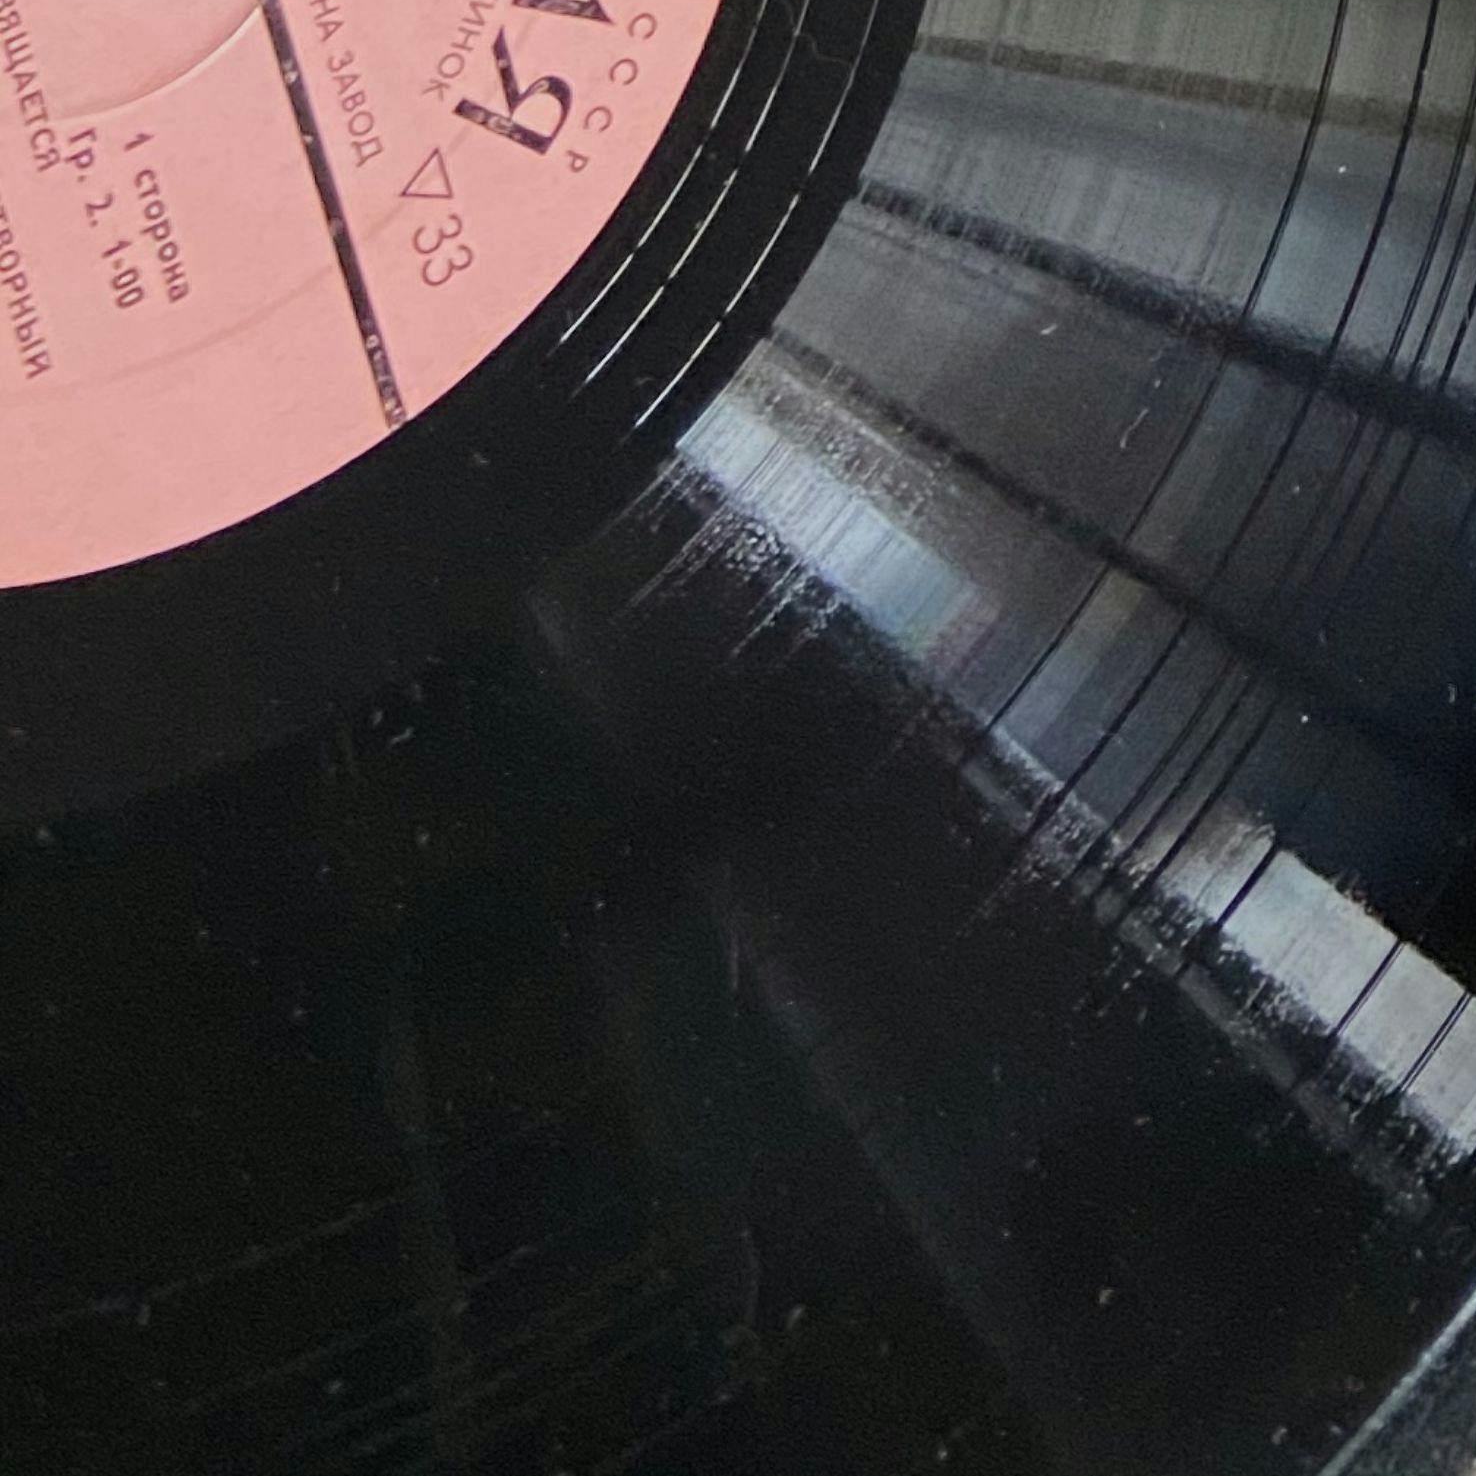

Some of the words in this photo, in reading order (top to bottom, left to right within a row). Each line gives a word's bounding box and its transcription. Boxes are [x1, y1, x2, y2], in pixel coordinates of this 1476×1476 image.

[124, 133, 154, 152] 1
[327, 50, 385, 168] ЗАВОД
[565, 12, 658, 173] СССР
[64, 127, 98, 182] Гр.
[85, 192, 114, 227] 2.
[134, 168, 190, 304] сторона
[0, 205, 52, 379] ВОРНЫЙ
[412, 213, 474, 287] 33
